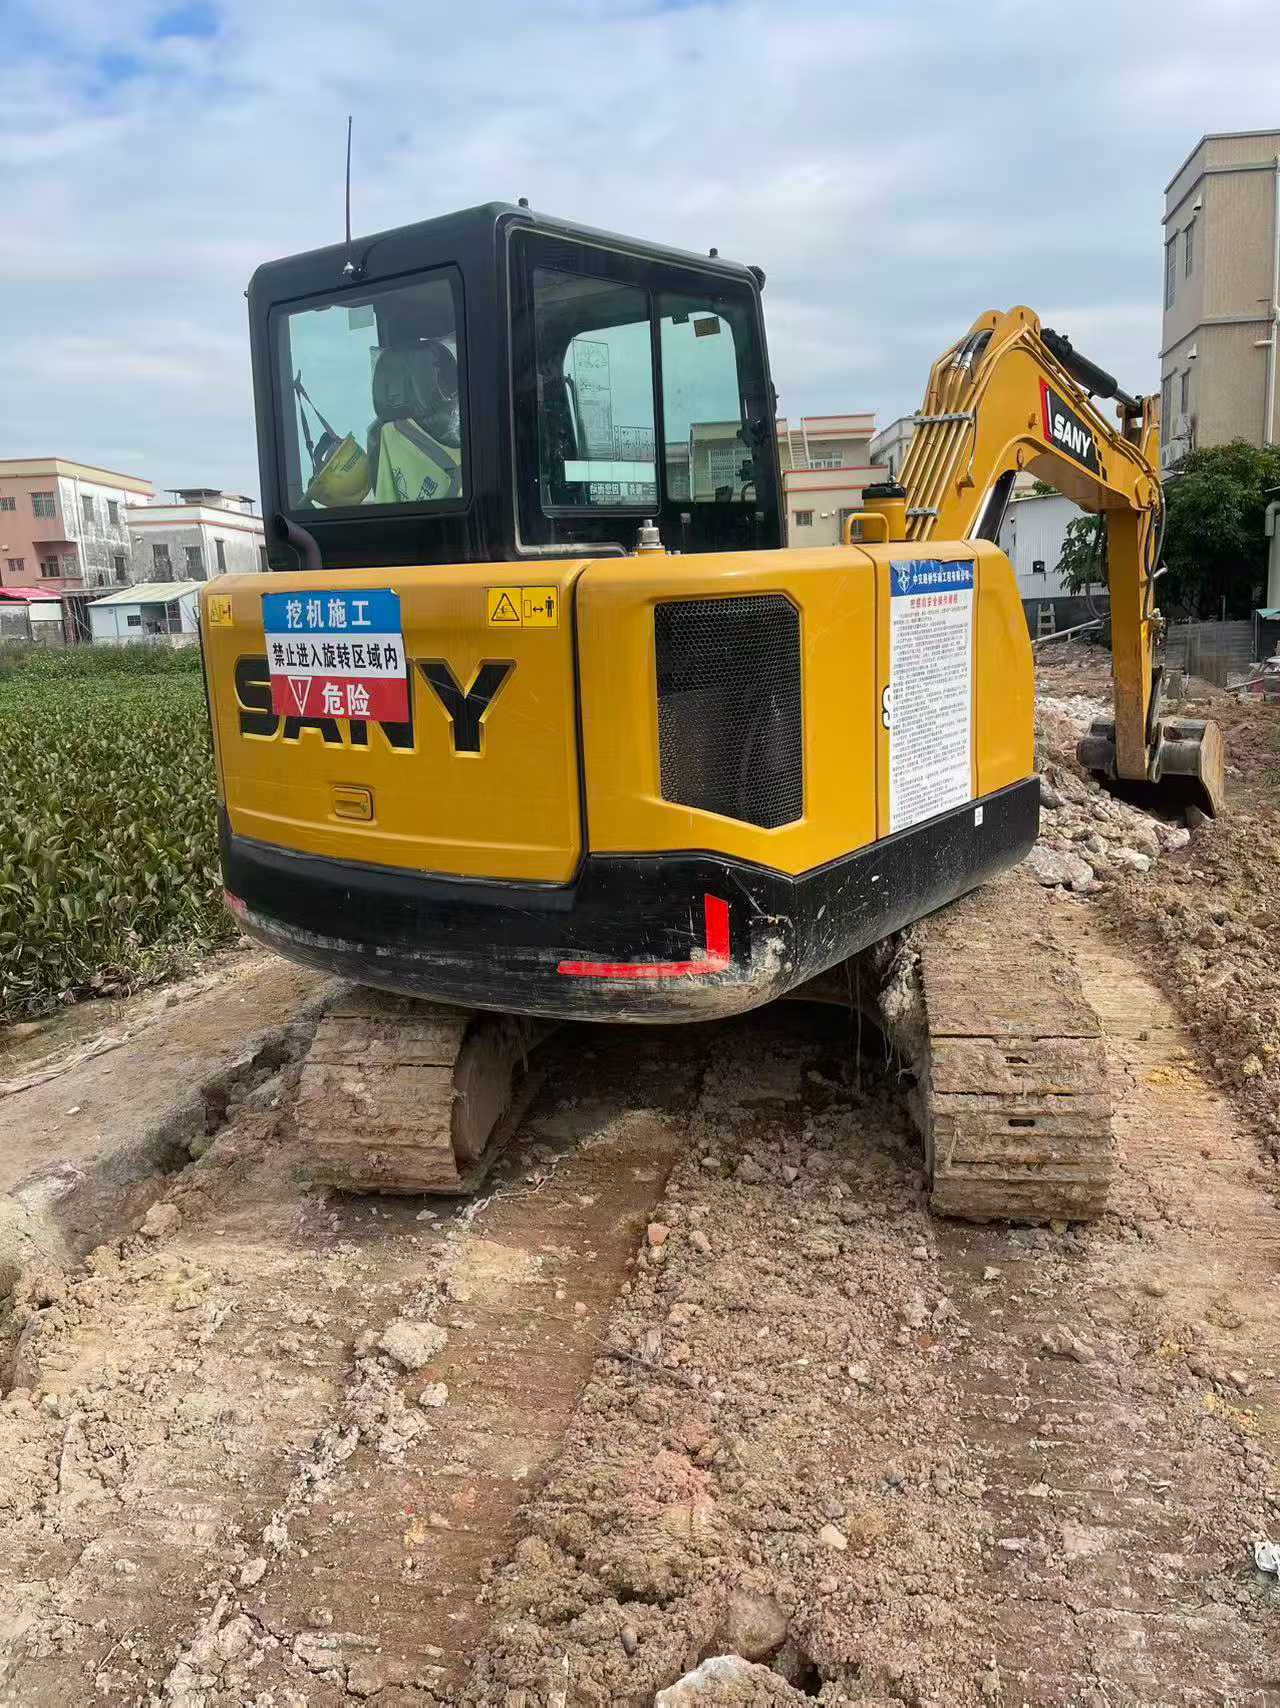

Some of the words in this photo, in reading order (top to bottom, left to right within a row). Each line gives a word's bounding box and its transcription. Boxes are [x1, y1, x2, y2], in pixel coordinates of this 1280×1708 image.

[1053, 413, 1092, 458] SANY
[286, 599, 371, 629] 挖机施工
[272, 642, 399, 671] 禁止进入旋转区域内
[235, 655, 516, 756] SY
[322, 681, 371, 717] 危险
